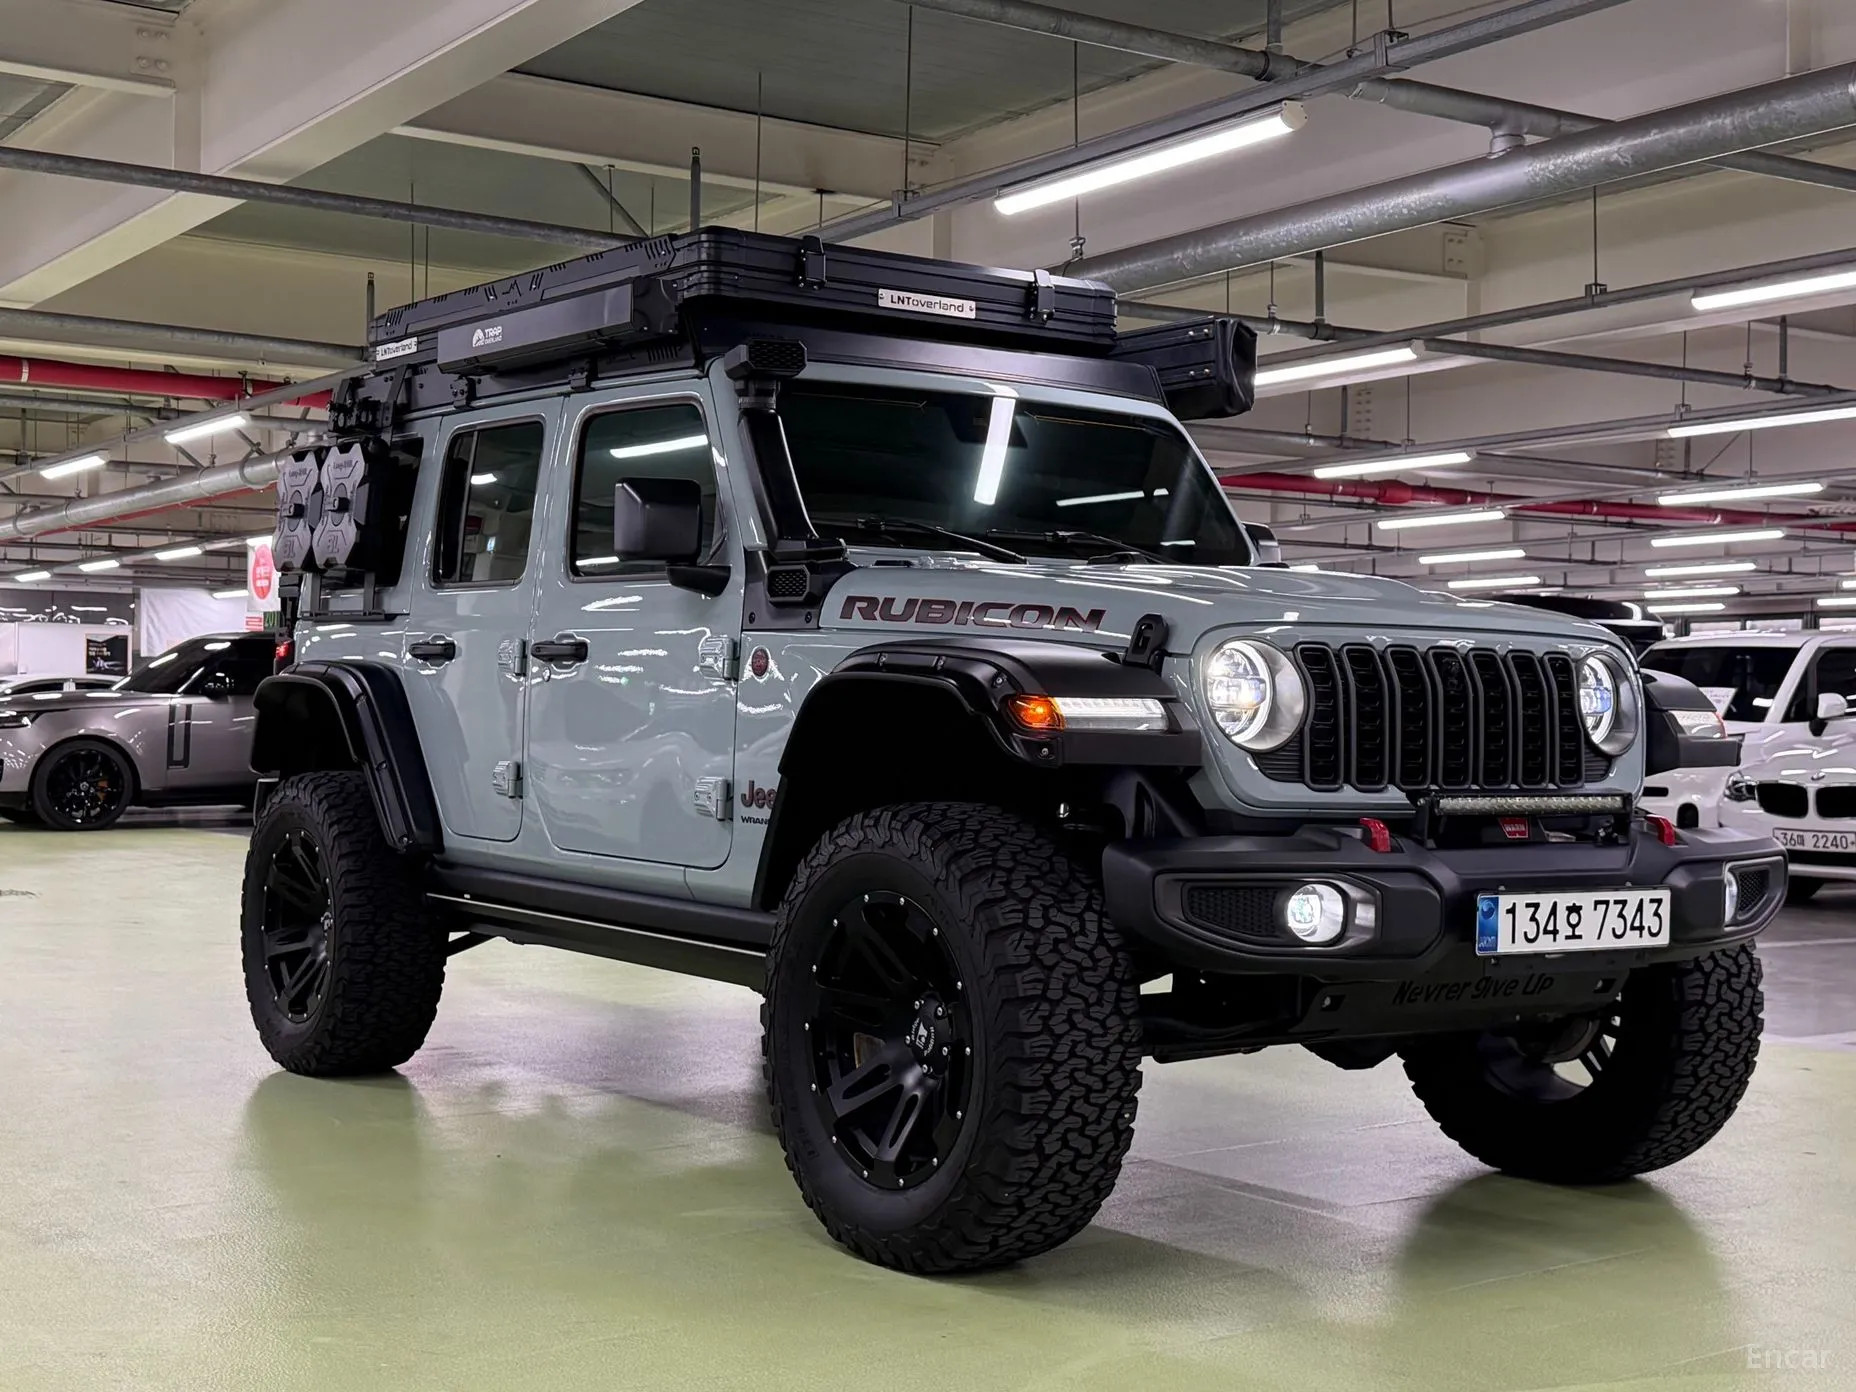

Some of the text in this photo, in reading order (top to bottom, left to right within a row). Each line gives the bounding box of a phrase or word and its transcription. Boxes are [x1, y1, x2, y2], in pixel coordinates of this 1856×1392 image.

[890, 294, 964, 312] LNToverland
[484, 326, 502, 338] TRAP
[380, 341, 412, 356] LNToverland
[839, 595, 1106, 633] RUBICON
[741, 780, 777, 809] Jee
[741, 815, 769, 825] WRAN
[1812, 834, 1848, 849] 2240
[1506, 898, 1663, 944] 134호 7343
[1393, 980, 1472, 1004] Nevrer
